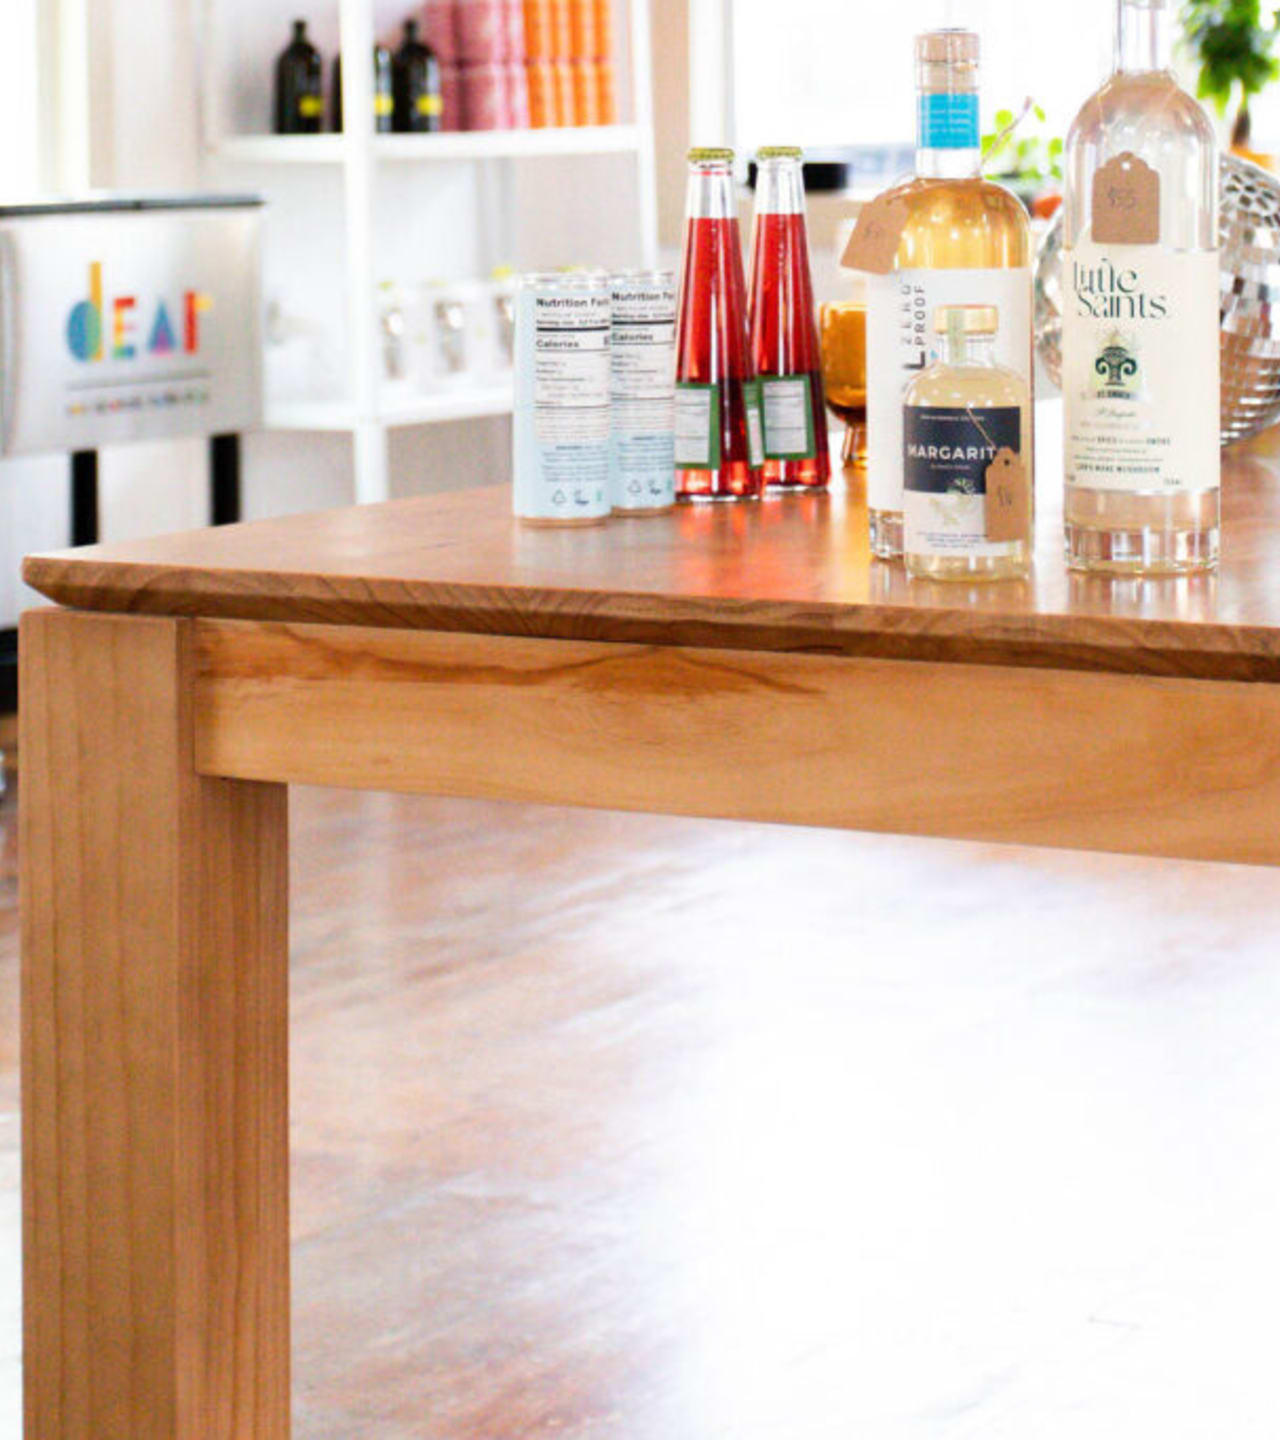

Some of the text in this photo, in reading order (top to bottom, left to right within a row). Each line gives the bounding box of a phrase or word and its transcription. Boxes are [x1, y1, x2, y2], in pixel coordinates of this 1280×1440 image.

[612, 292, 661, 301] Nutrition
[536, 298, 588, 308] Nutrition
[914, 285, 926, 346] PROOF
[612, 333, 654, 341] Calories
[536, 339, 579, 348] Calories
[907, 443, 995, 461] MARGARIT
